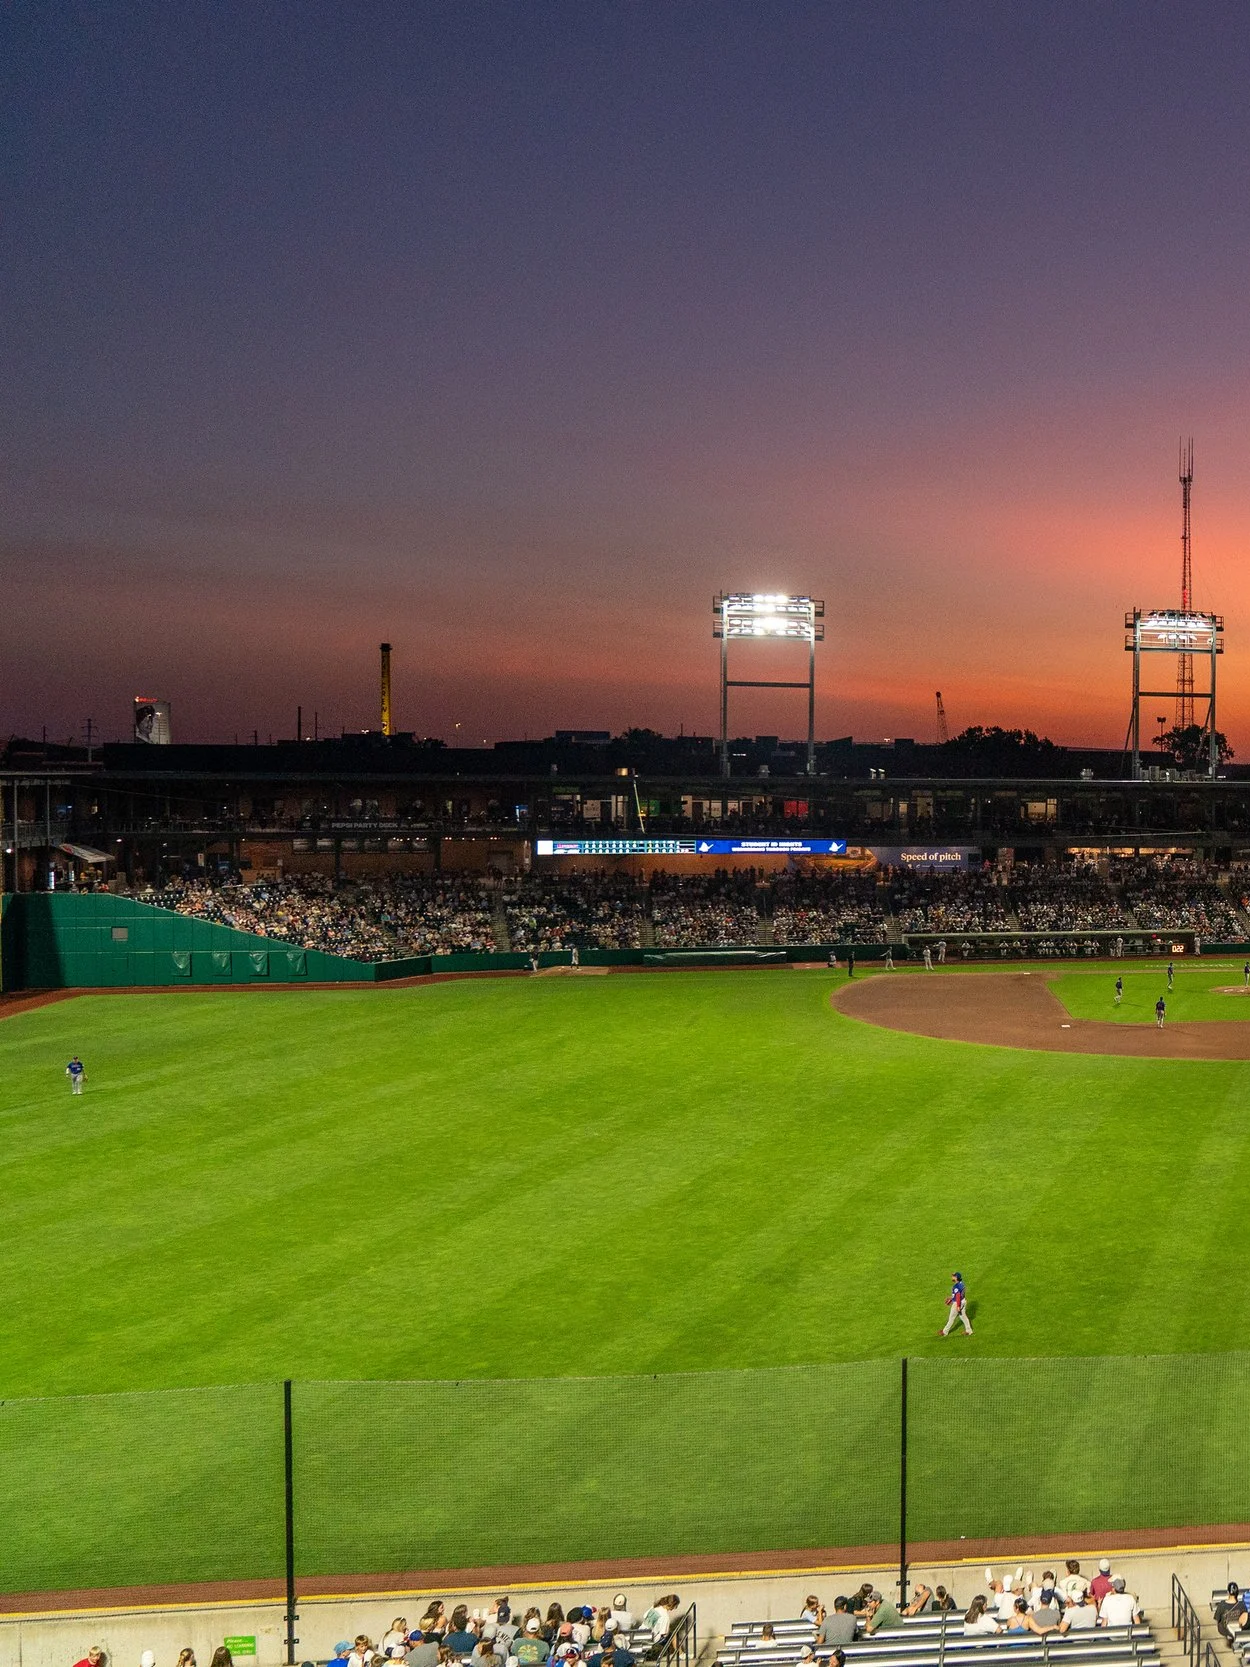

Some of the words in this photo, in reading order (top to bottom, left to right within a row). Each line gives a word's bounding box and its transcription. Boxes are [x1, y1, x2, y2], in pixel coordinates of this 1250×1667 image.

[900, 852, 927, 863] Speed
[928, 852, 939, 861] of
[939, 852, 961, 863] pitch
